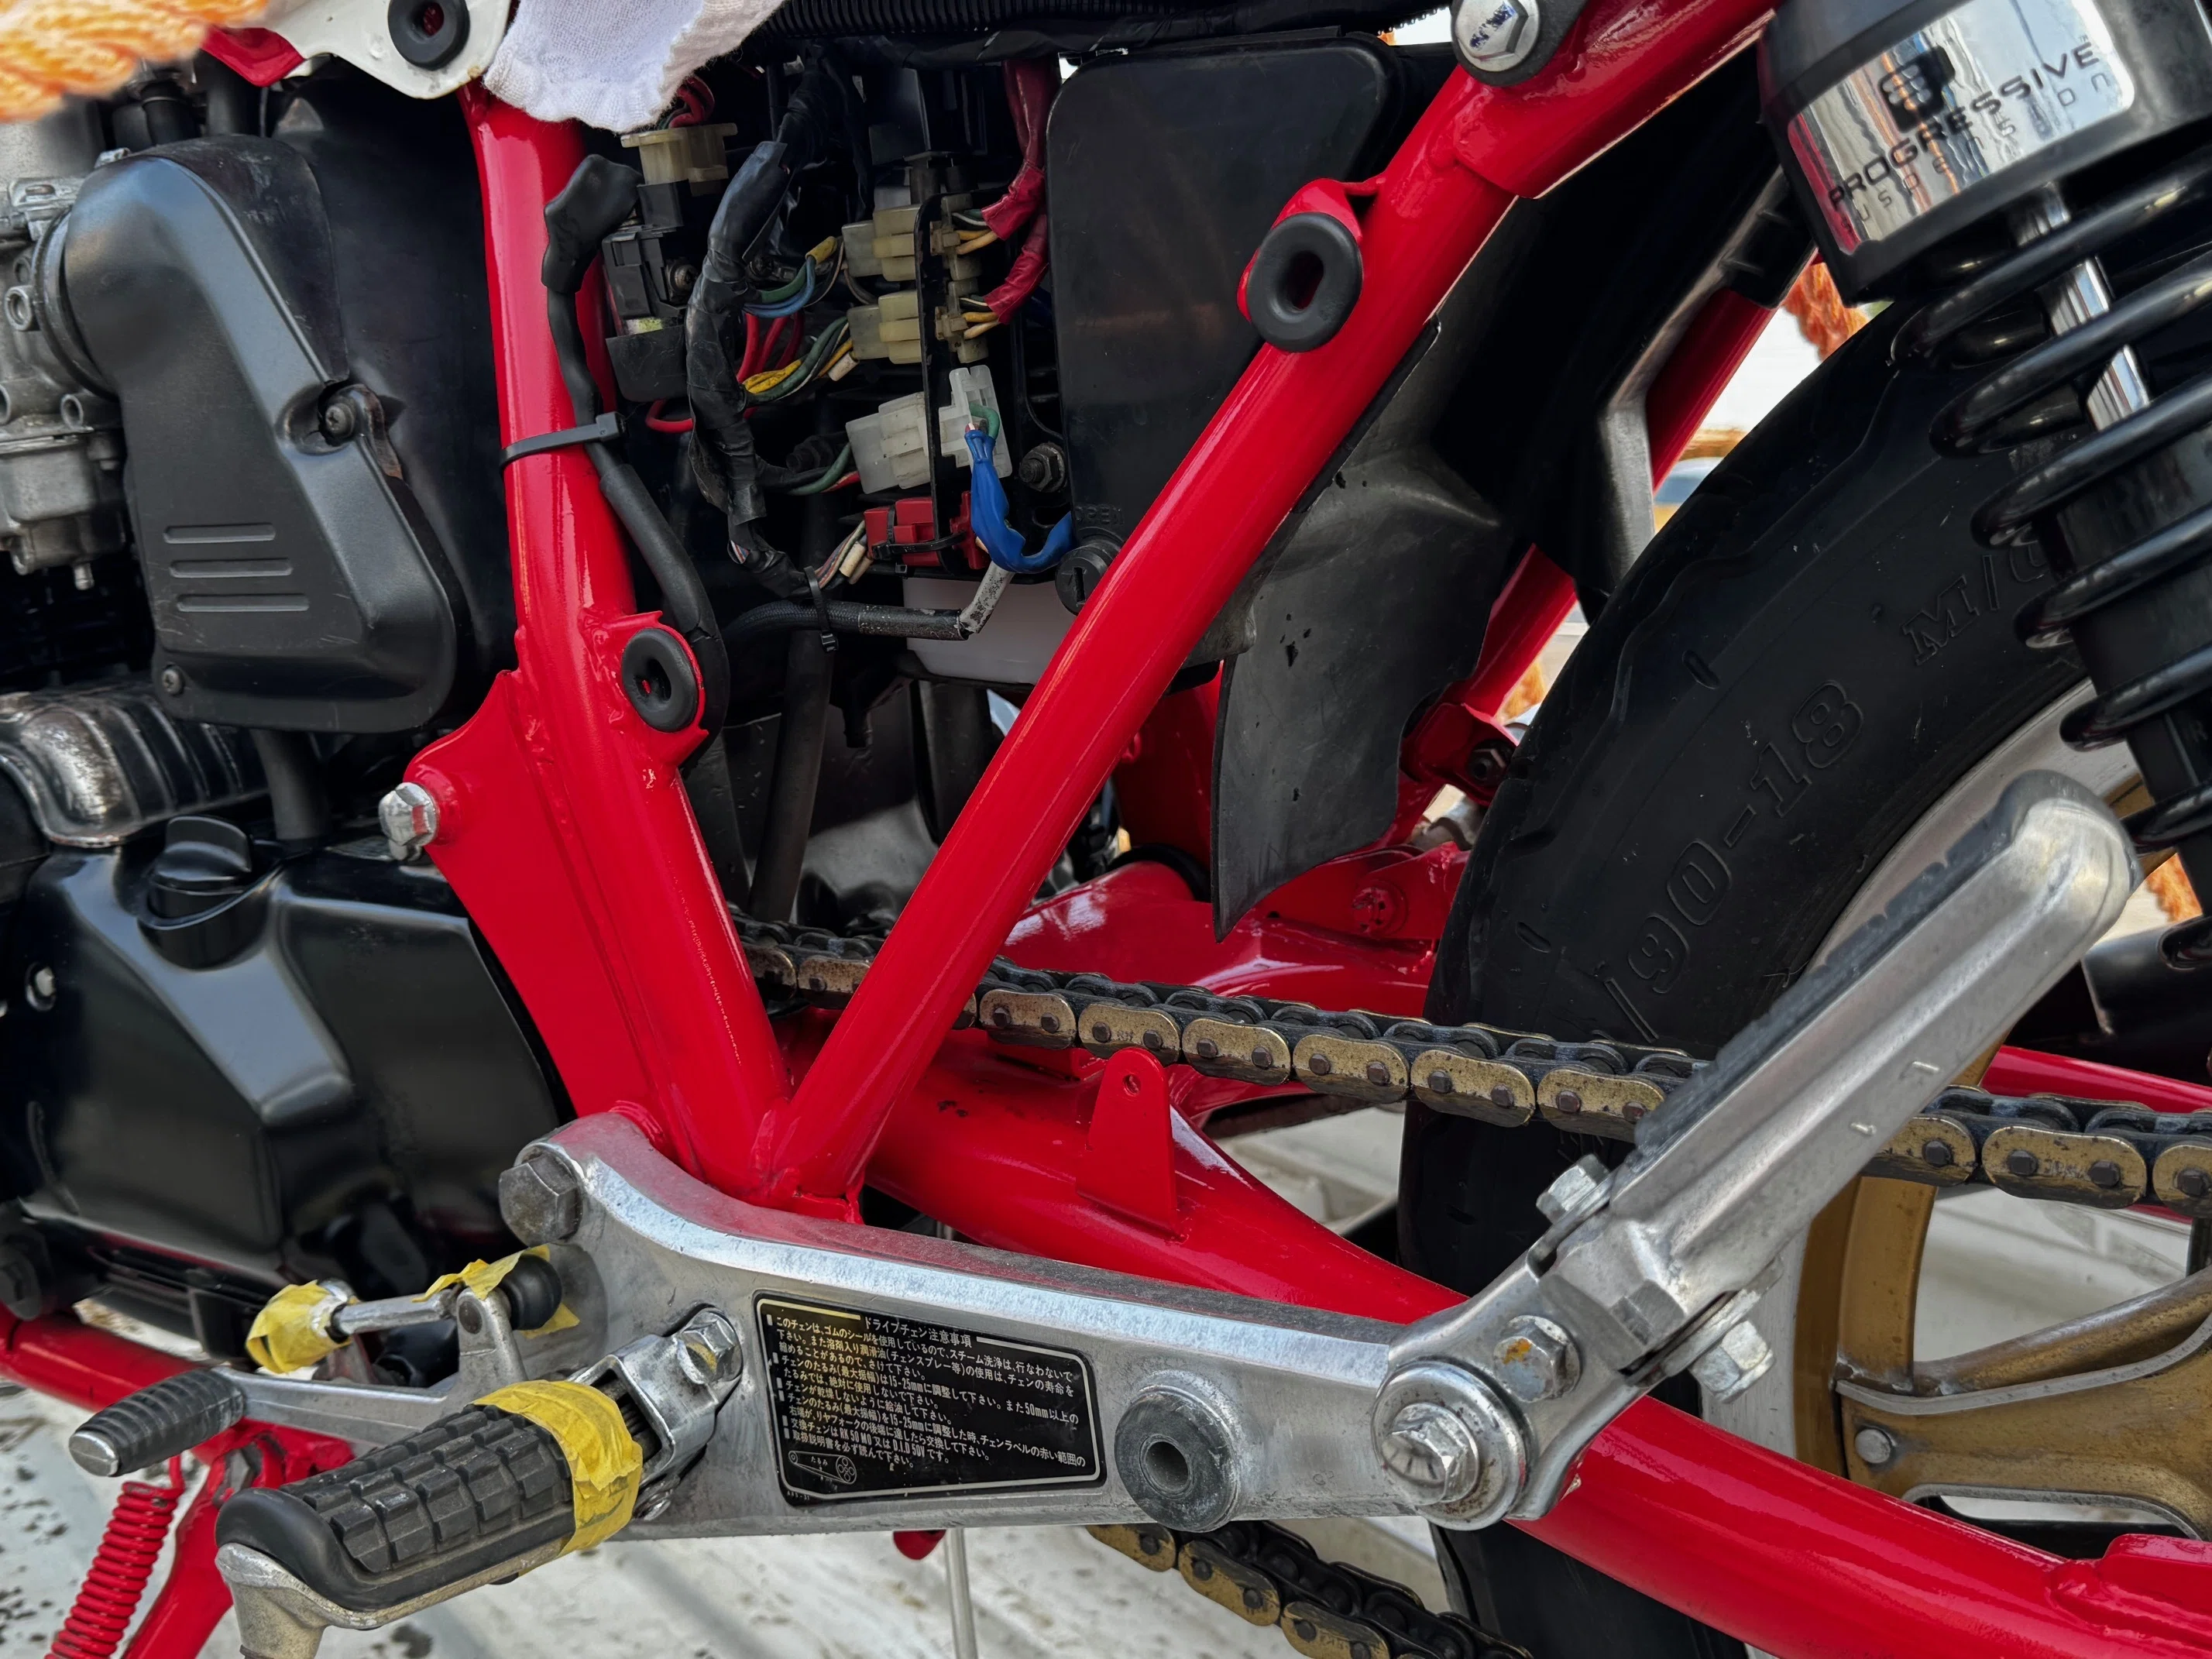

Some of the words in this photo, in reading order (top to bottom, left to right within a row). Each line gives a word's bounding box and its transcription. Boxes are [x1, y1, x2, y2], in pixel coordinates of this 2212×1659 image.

[863, 1317, 973, 1348] ドライブチェン注意事項
